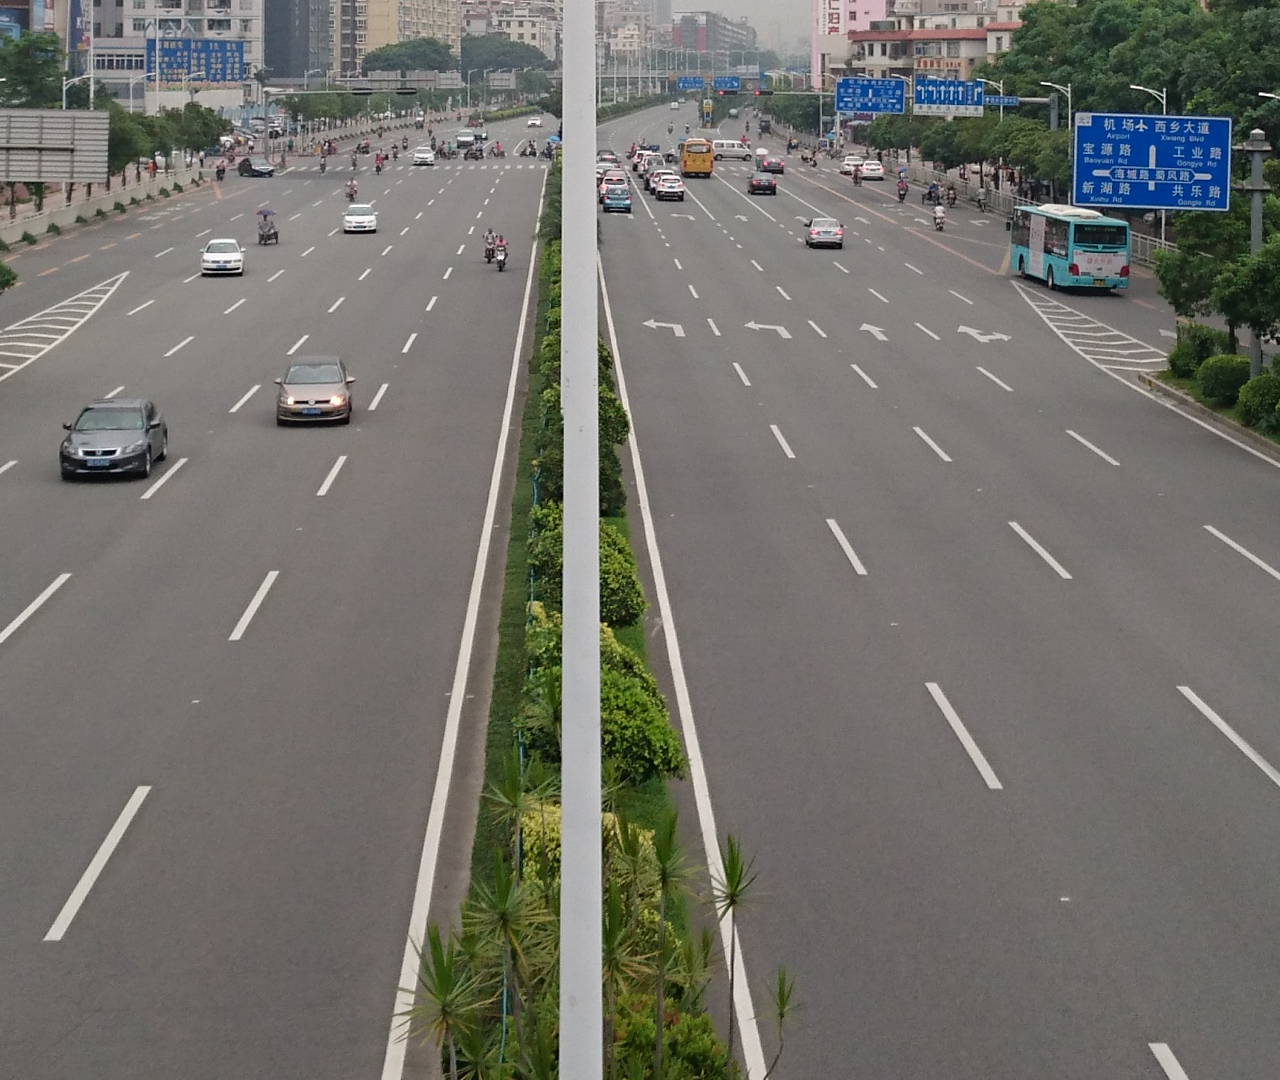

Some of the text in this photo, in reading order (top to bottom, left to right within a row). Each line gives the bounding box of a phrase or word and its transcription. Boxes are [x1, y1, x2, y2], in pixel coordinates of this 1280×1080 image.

[1103, 118, 1134, 132] 机场
[1155, 120, 1210, 134] 西乡大道
[1161, 135, 1185, 143] Xixiang
[1082, 142, 1222, 160] 宝源路 工业路
[1081, 181, 1221, 199] 新湖路 共乐路
